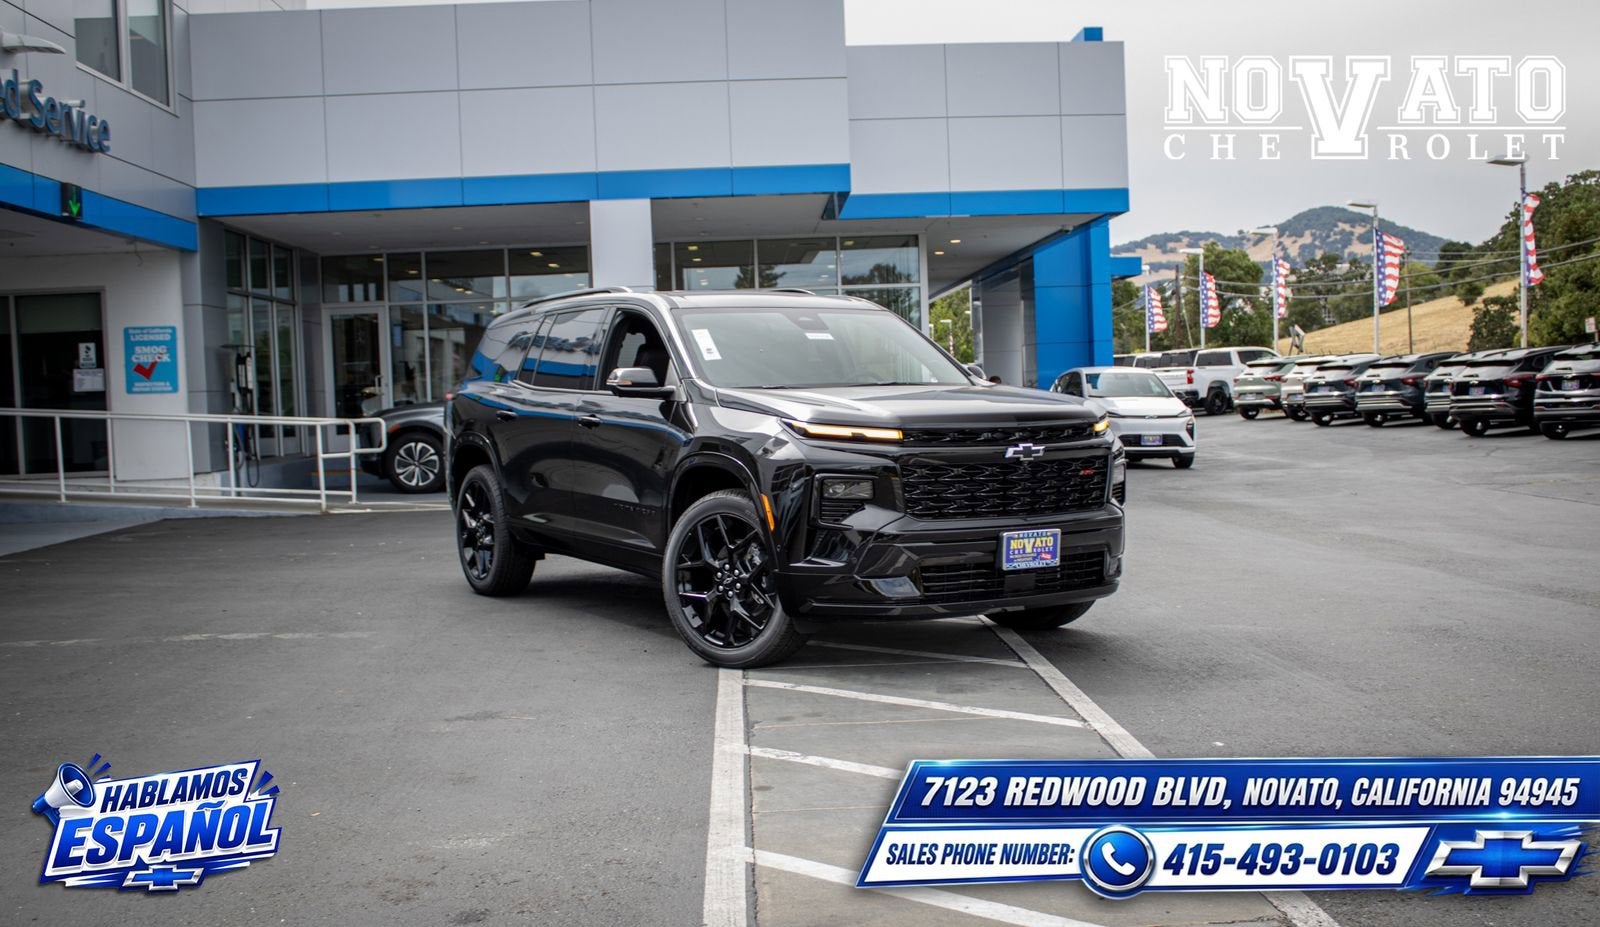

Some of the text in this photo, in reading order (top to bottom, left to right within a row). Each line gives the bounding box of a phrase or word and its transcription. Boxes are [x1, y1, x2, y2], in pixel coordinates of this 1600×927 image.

[0, 69, 111, 152] d Service
[134, 345, 168, 353] SMOG
[131, 354, 171, 362] CHECK
[1010, 536, 1054, 553] NOVATO
